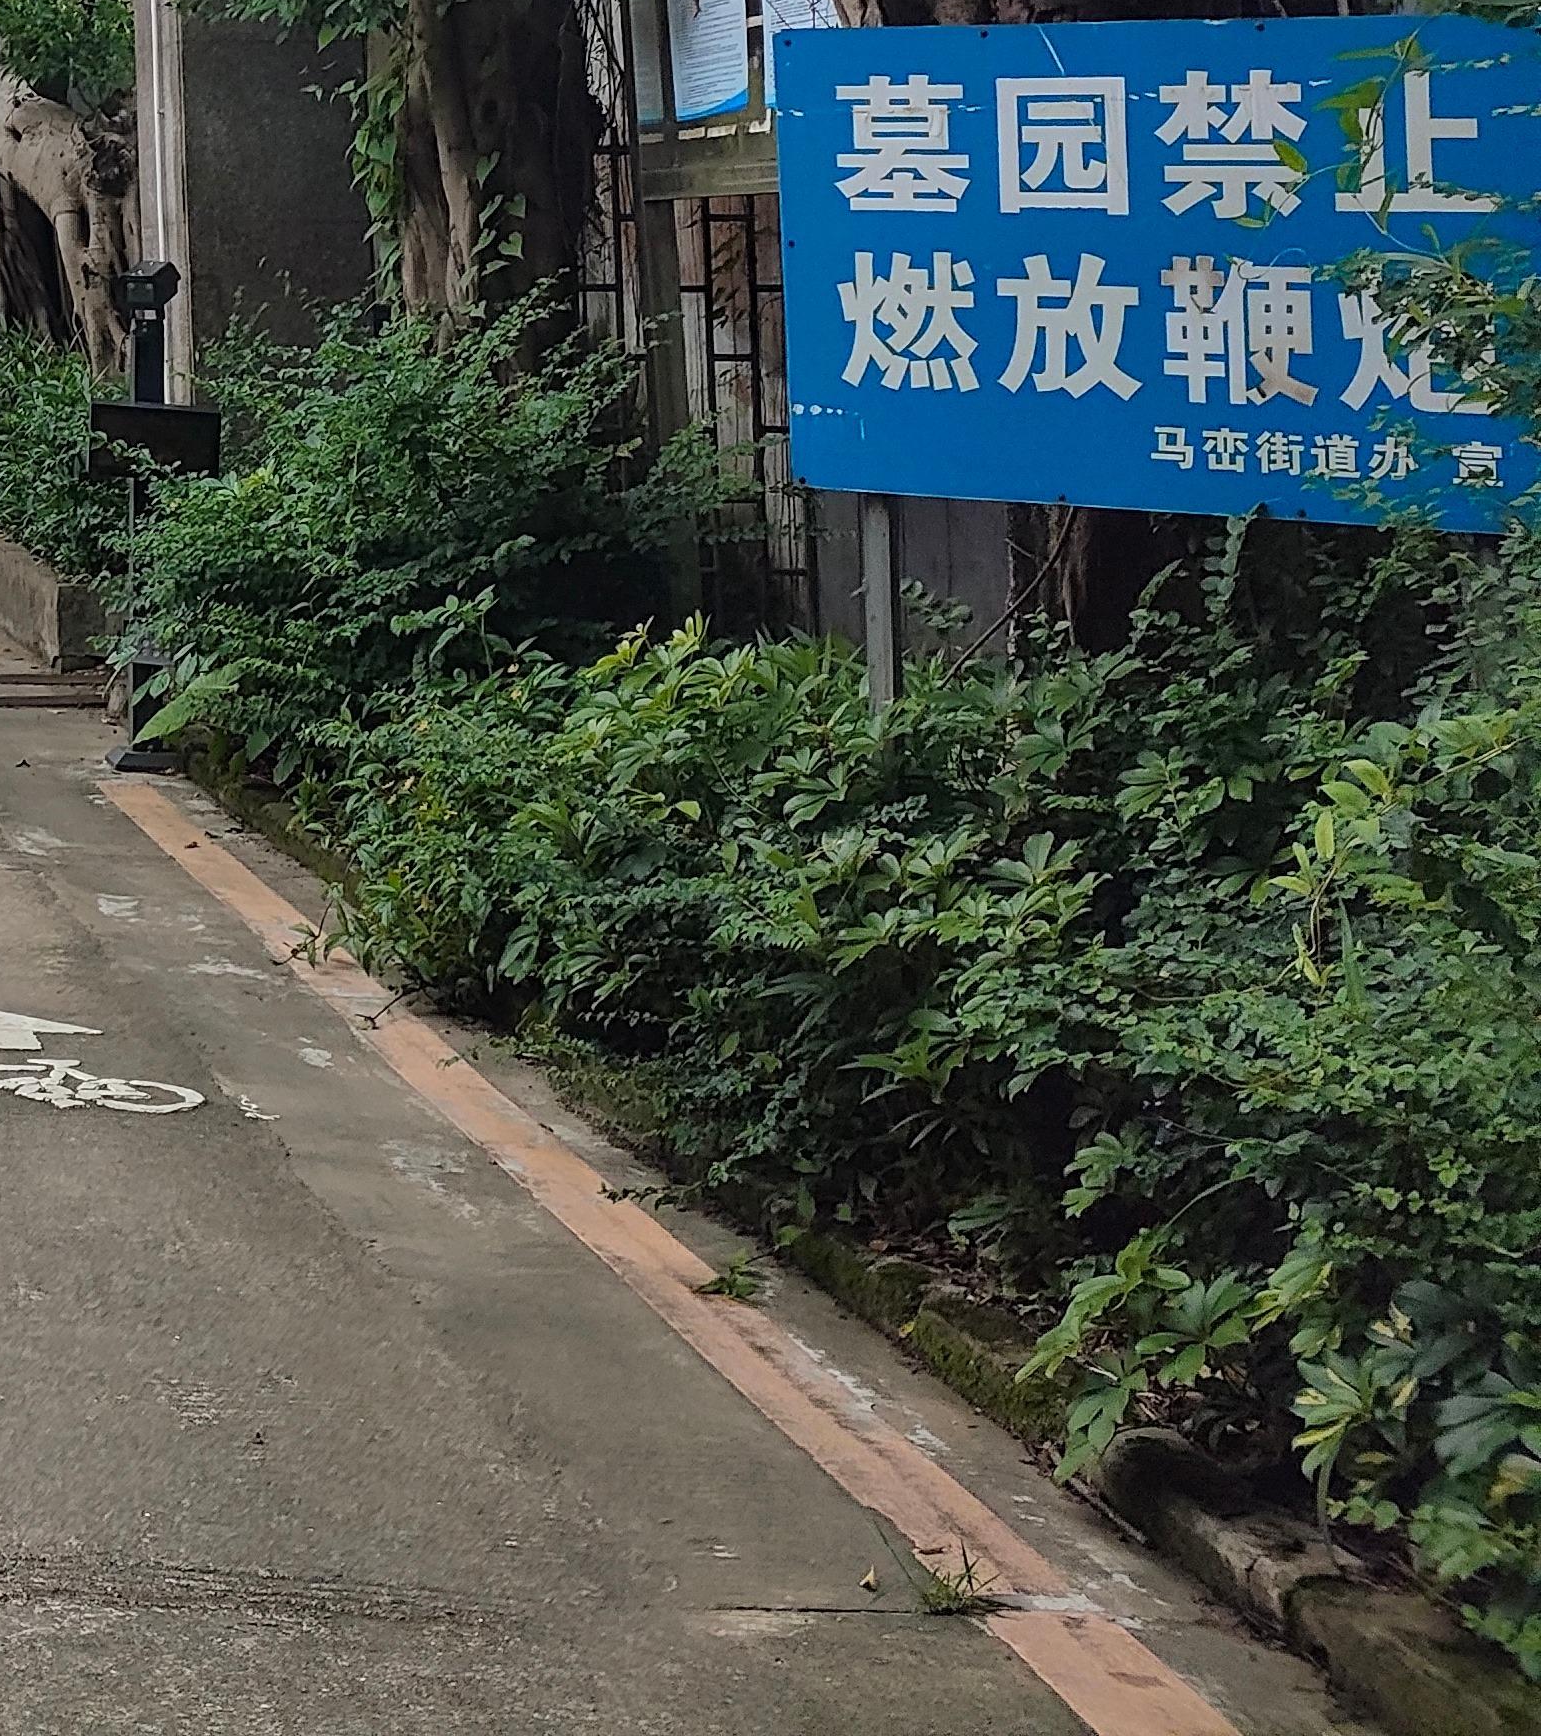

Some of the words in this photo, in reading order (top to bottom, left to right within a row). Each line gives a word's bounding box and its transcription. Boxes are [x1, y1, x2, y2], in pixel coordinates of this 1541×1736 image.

[835, 70, 1501, 217] 墓园禁止
[1150, 426, 1419, 480] 马峦街道办
